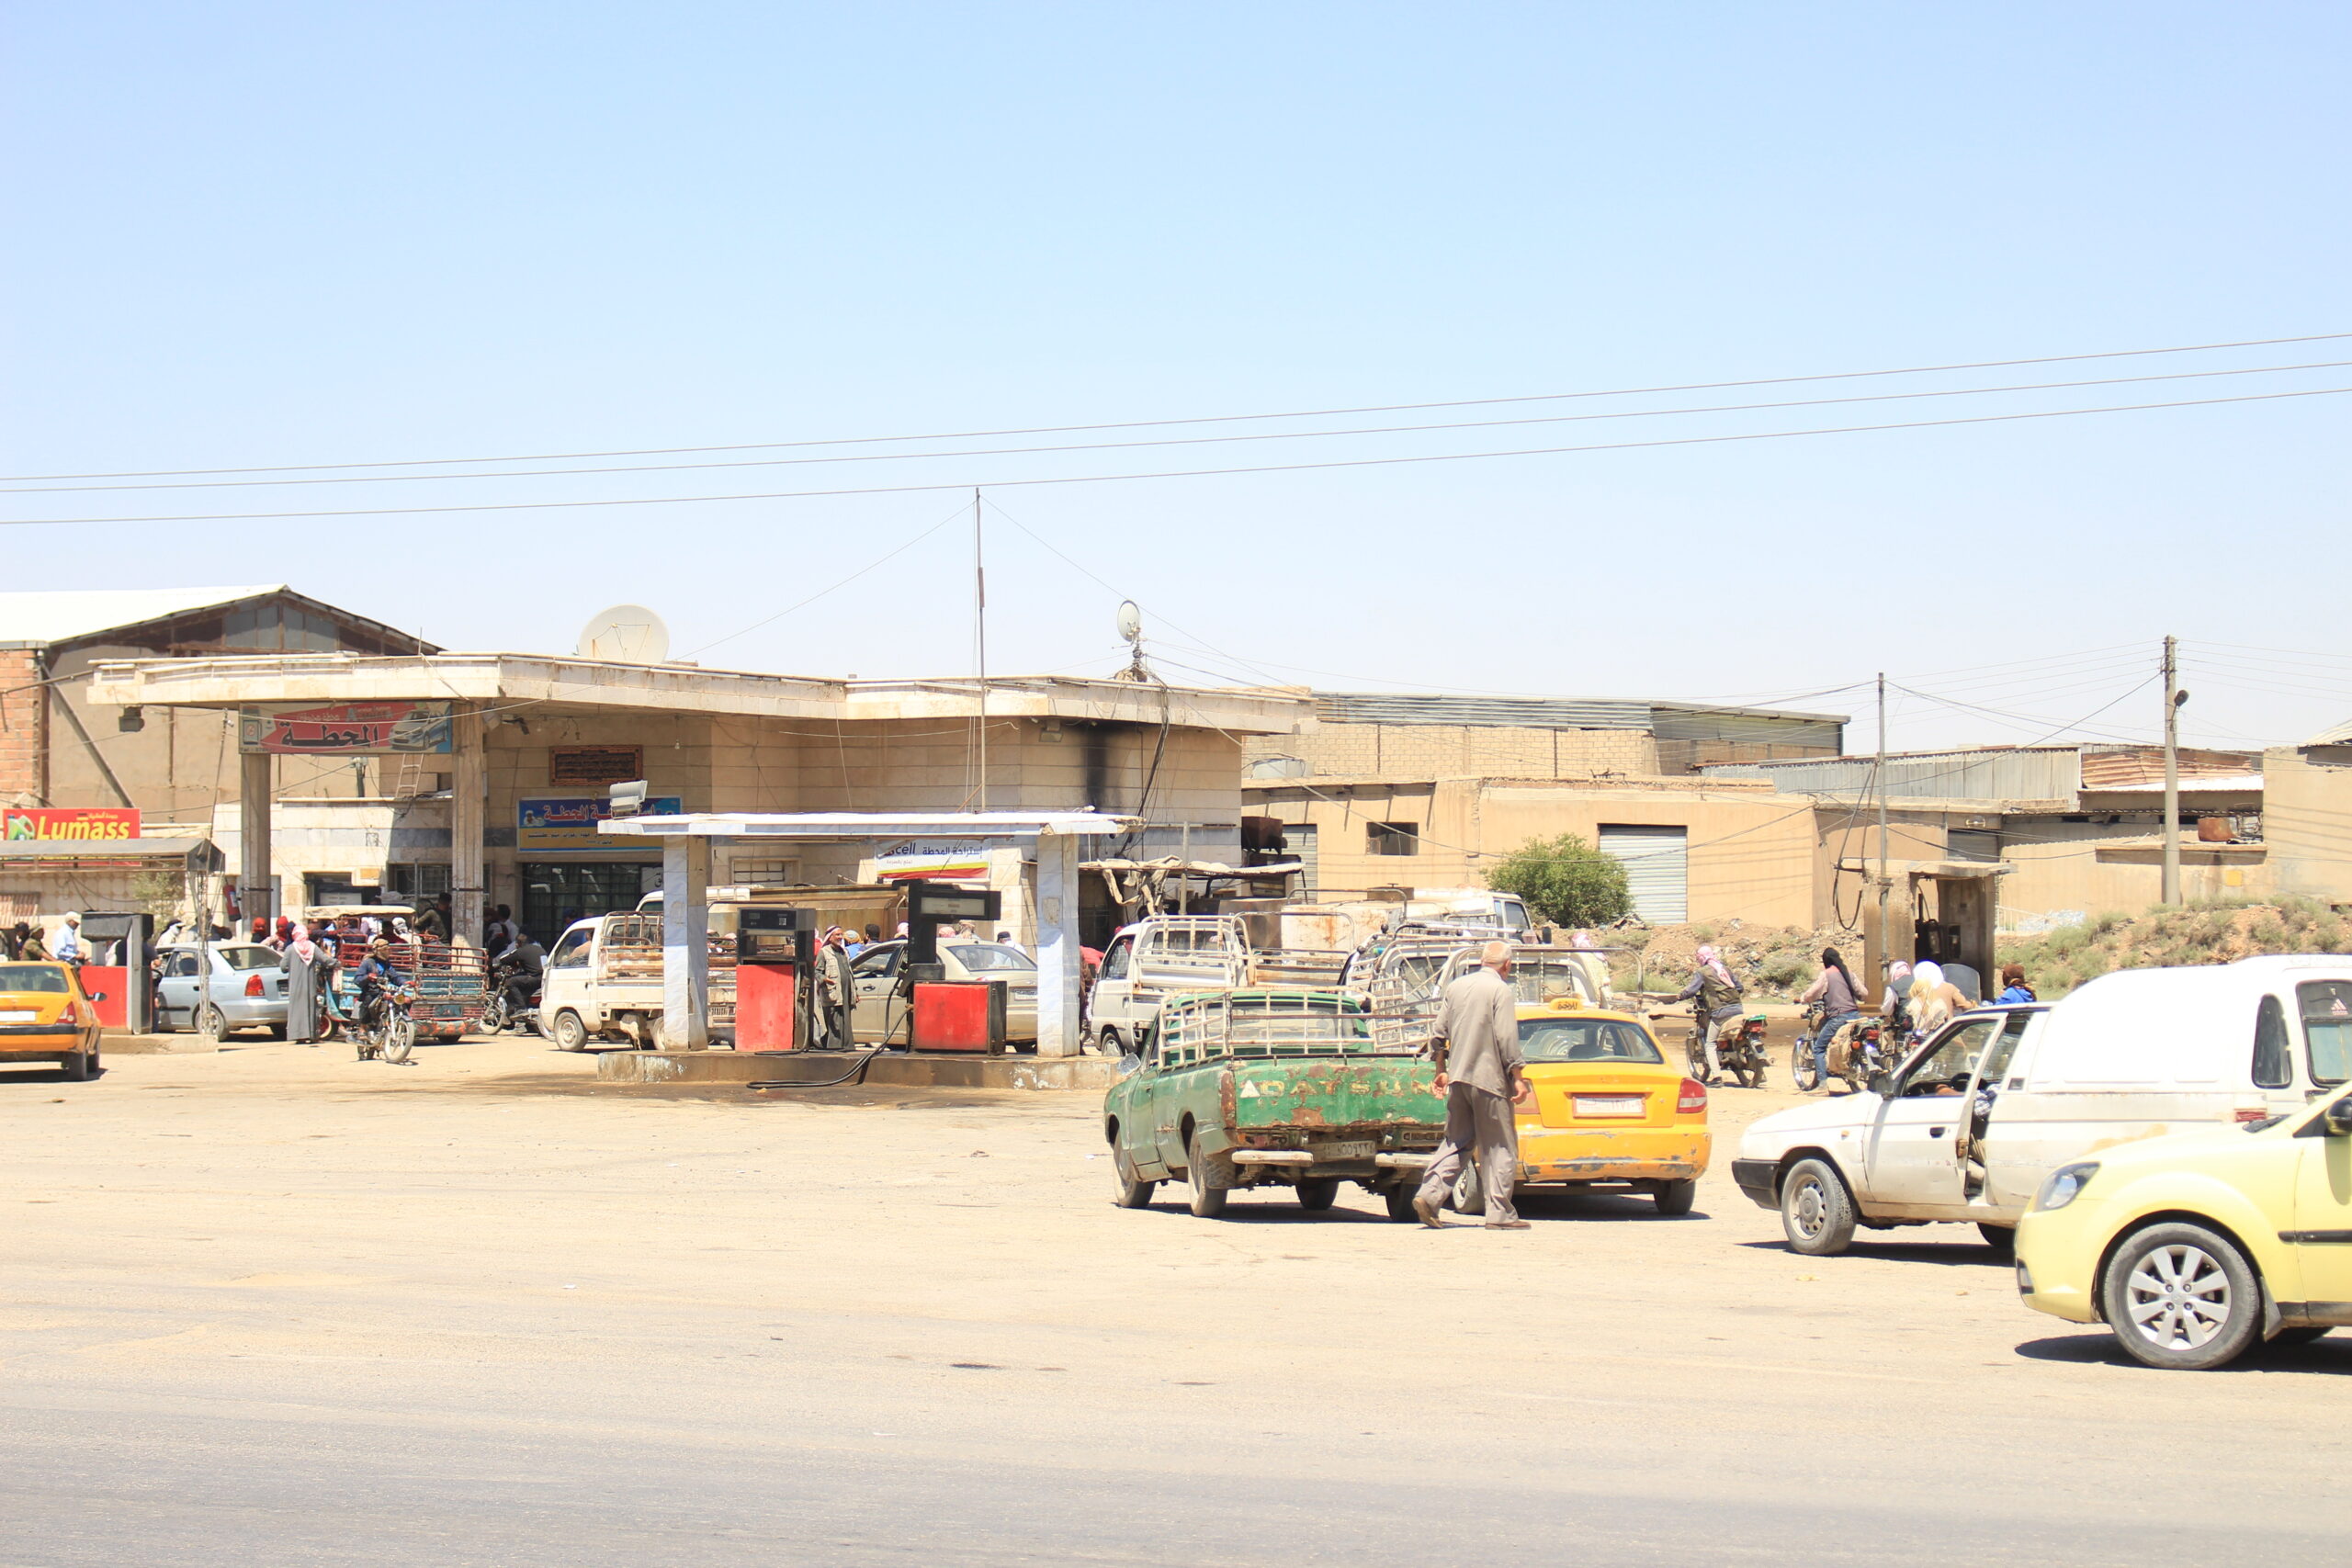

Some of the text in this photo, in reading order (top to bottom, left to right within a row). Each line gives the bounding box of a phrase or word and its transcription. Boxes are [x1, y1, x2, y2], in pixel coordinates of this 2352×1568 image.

[279, 721, 379, 747] المحطة
[543, 804, 588, 822] المحطة
[37, 816, 130, 840] Lumass
[891, 842, 916, 855] cell
[922, 845, 950, 856] المحطة
[1260, 1078, 1434, 1098] DATSUN
